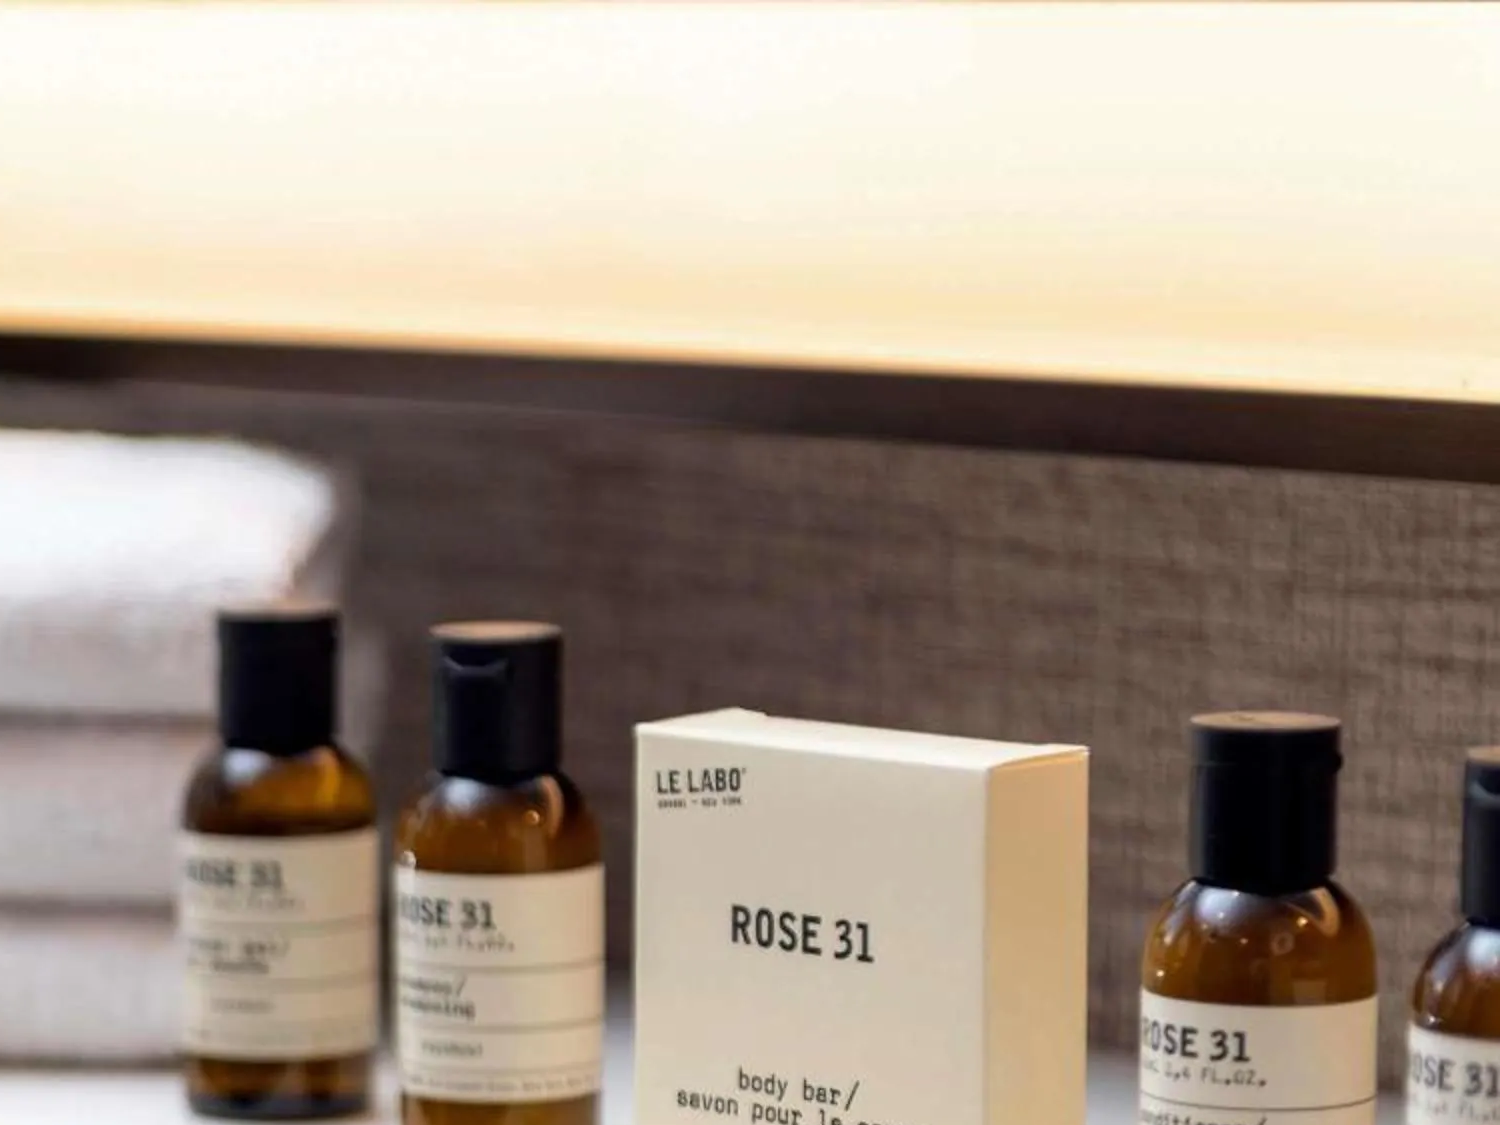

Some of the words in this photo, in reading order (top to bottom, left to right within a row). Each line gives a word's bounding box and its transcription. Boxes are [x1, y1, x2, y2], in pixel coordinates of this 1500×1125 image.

[656, 769, 682, 795] LE
[687, 767, 743, 793] LABO
[459, 898, 496, 930] 31
[730, 904, 822, 956] ROSE
[833, 919, 875, 963] 31
[1209, 1029, 1252, 1063] 31
[738, 1066, 789, 1102] body
[802, 1078, 861, 1111] bar/
[1408, 1053, 1455, 1091] OSE
[1464, 1061, 1500, 1100] 31
[677, 1088, 739, 1116] savon
